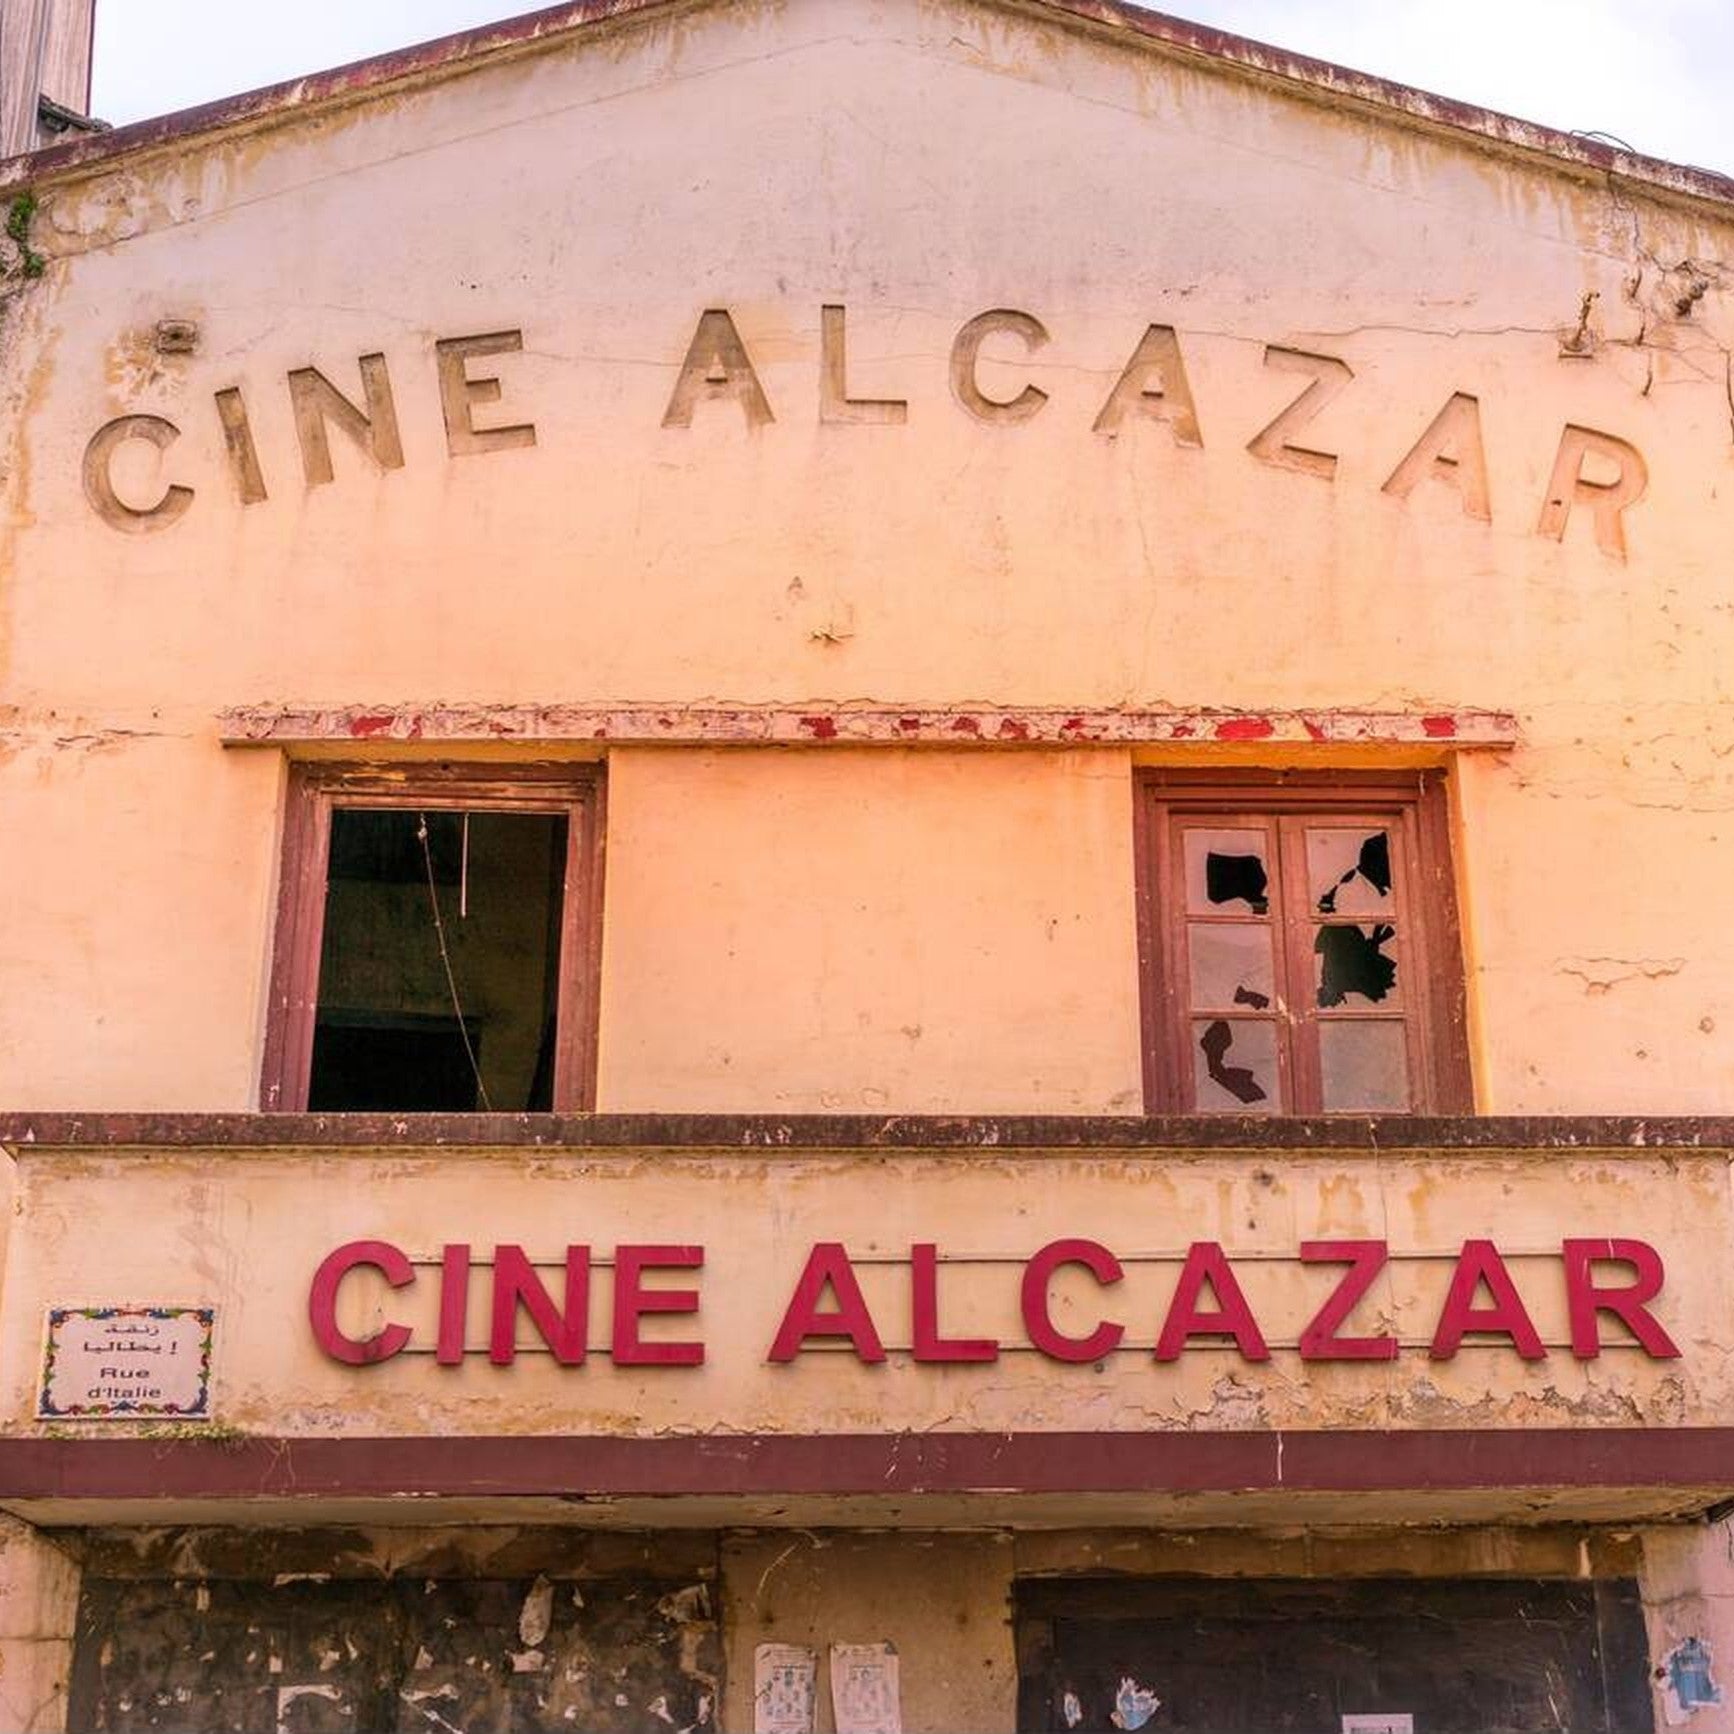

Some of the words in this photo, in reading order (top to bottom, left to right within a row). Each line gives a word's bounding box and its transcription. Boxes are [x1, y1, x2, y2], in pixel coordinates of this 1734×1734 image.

[82, 328, 537, 535] CINE
[661, 303, 1649, 563] ALCAZAR
[309, 1240, 705, 1367] CINE
[768, 1238, 1682, 1363] ALCAZAR
[87, 1386, 162, 1399] d'Italie
[100, 1367, 150, 1379] Rue
